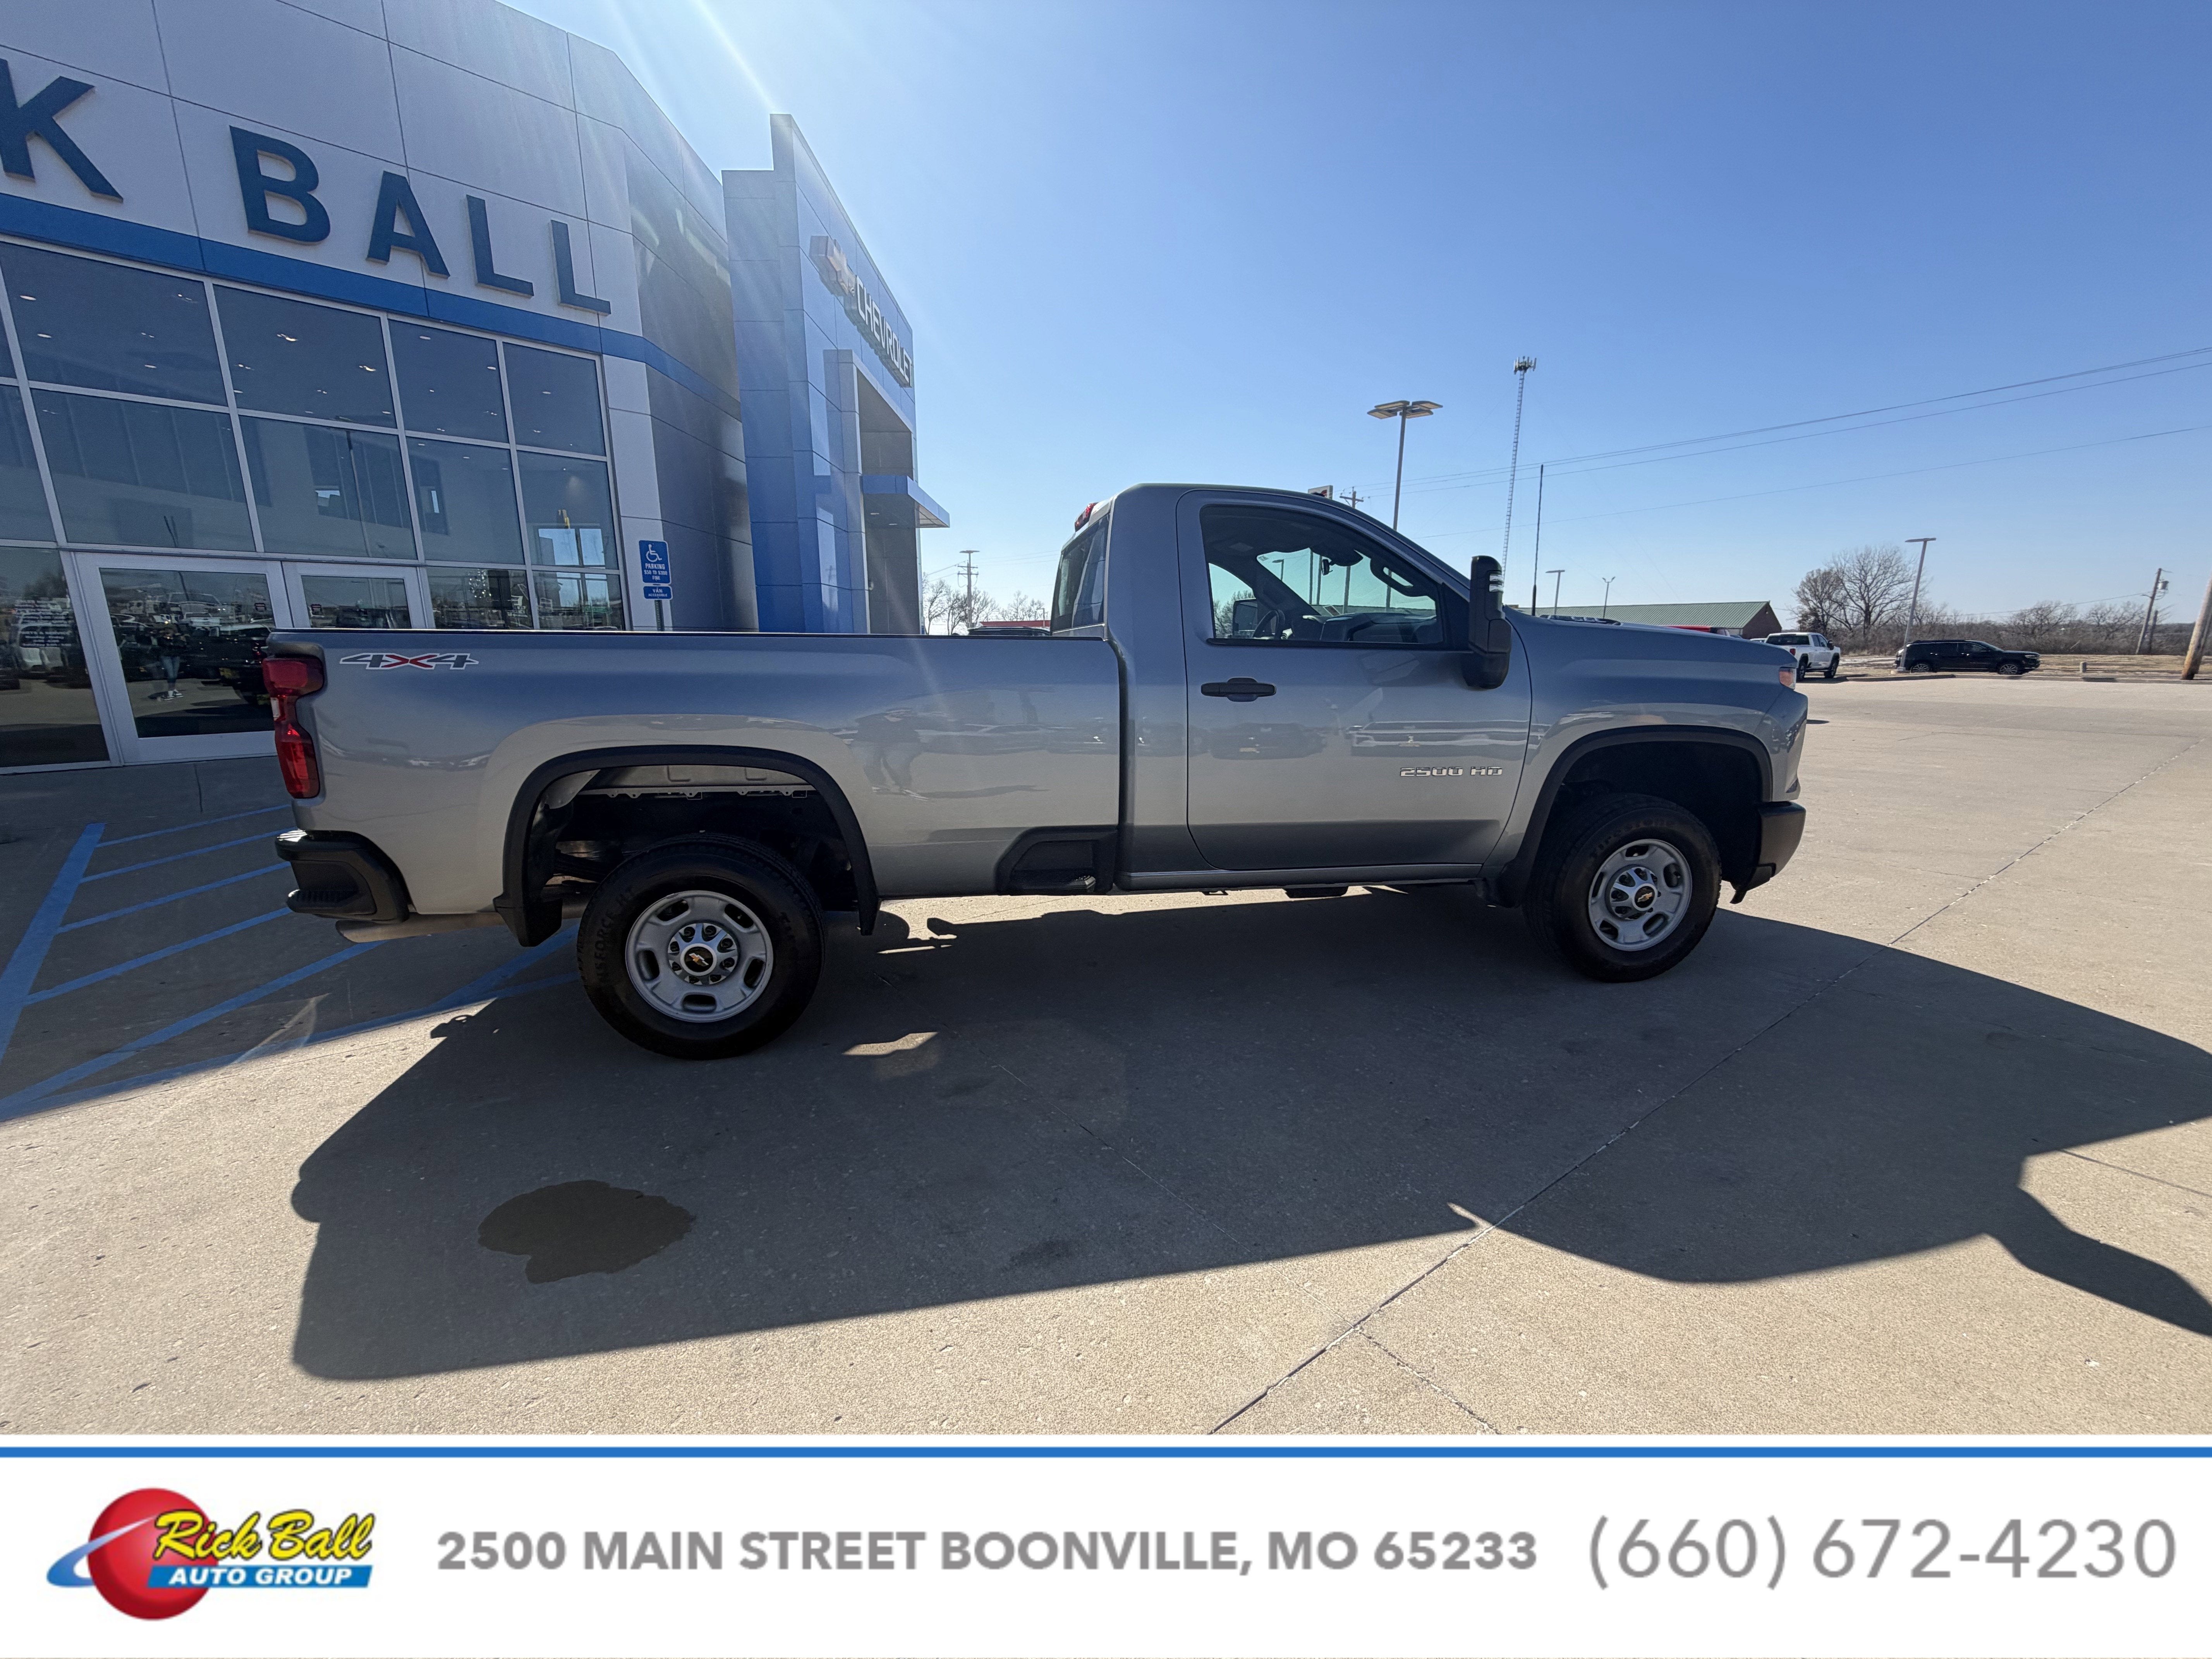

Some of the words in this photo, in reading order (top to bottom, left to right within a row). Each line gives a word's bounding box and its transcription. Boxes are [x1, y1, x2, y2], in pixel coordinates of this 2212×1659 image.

[229, 125, 611, 316] BALL
[856, 275, 913, 388] CHEVROLET
[1400, 766, 1463, 776] 2500
[1470, 766, 1503, 775] HD
